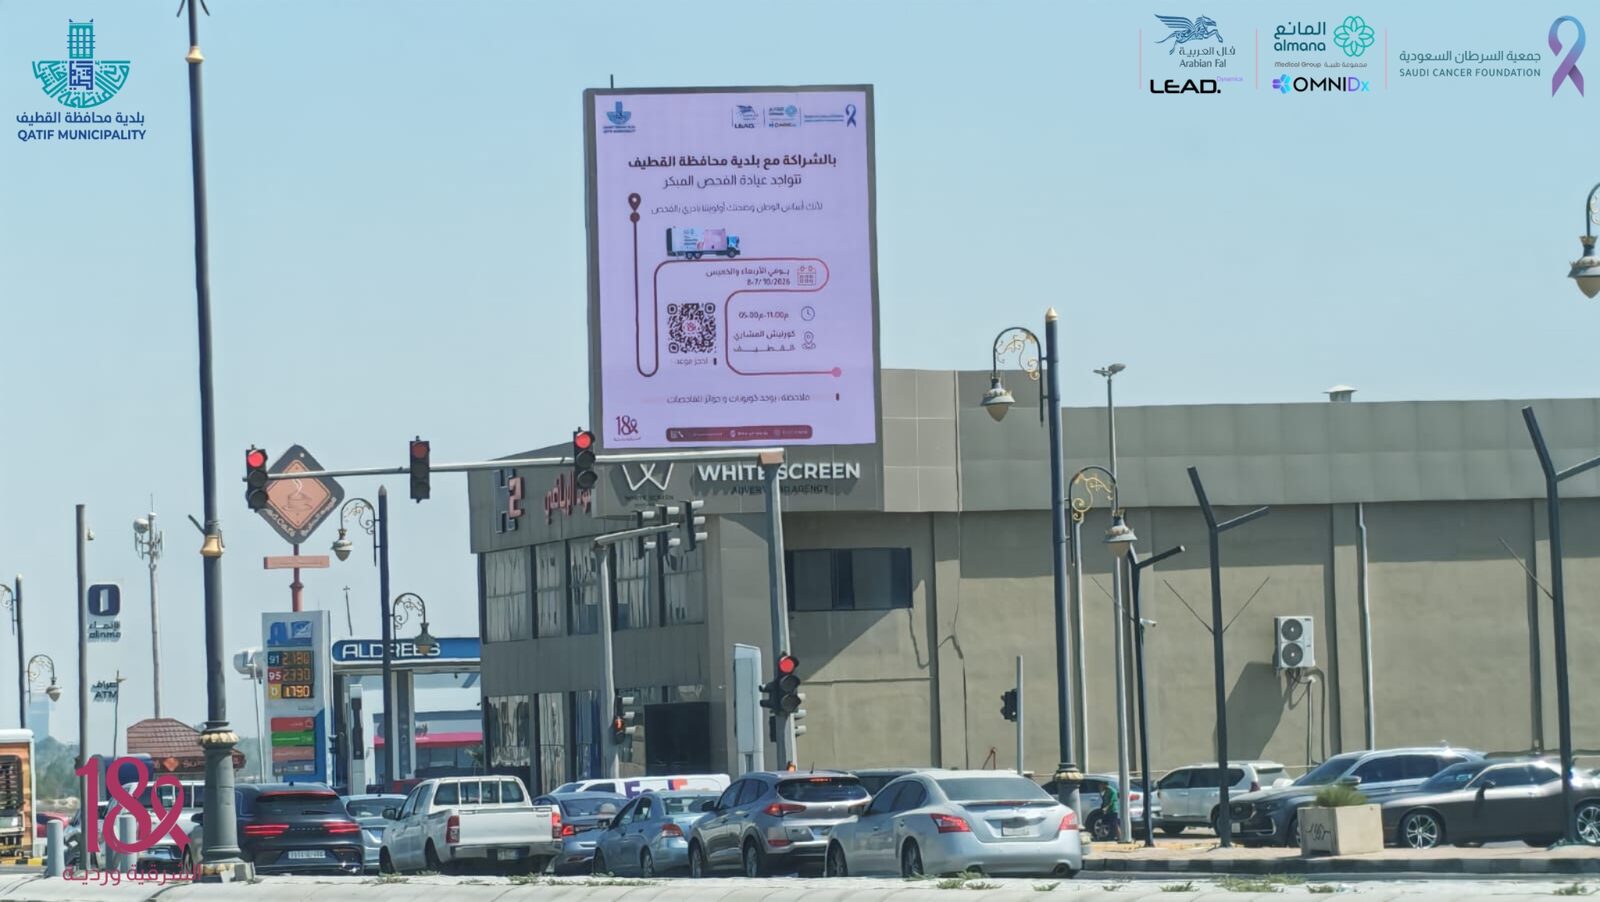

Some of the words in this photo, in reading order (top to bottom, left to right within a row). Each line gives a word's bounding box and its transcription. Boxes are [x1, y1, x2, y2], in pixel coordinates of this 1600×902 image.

[628, 156, 676, 170] القطيف
[679, 155, 728, 167] محافظة
[730, 154, 760, 168] بلدية
[763, 158, 780, 170] مع
[783, 152, 837, 168] بالشراكة
[662, 175, 694, 189] المبكر
[697, 174, 737, 189] الفحص
[739, 174, 767, 187] عيادة
[777, 462, 862, 480] SCREEN
[269, 655, 280, 665] 91
[269, 671, 282, 681] 95
